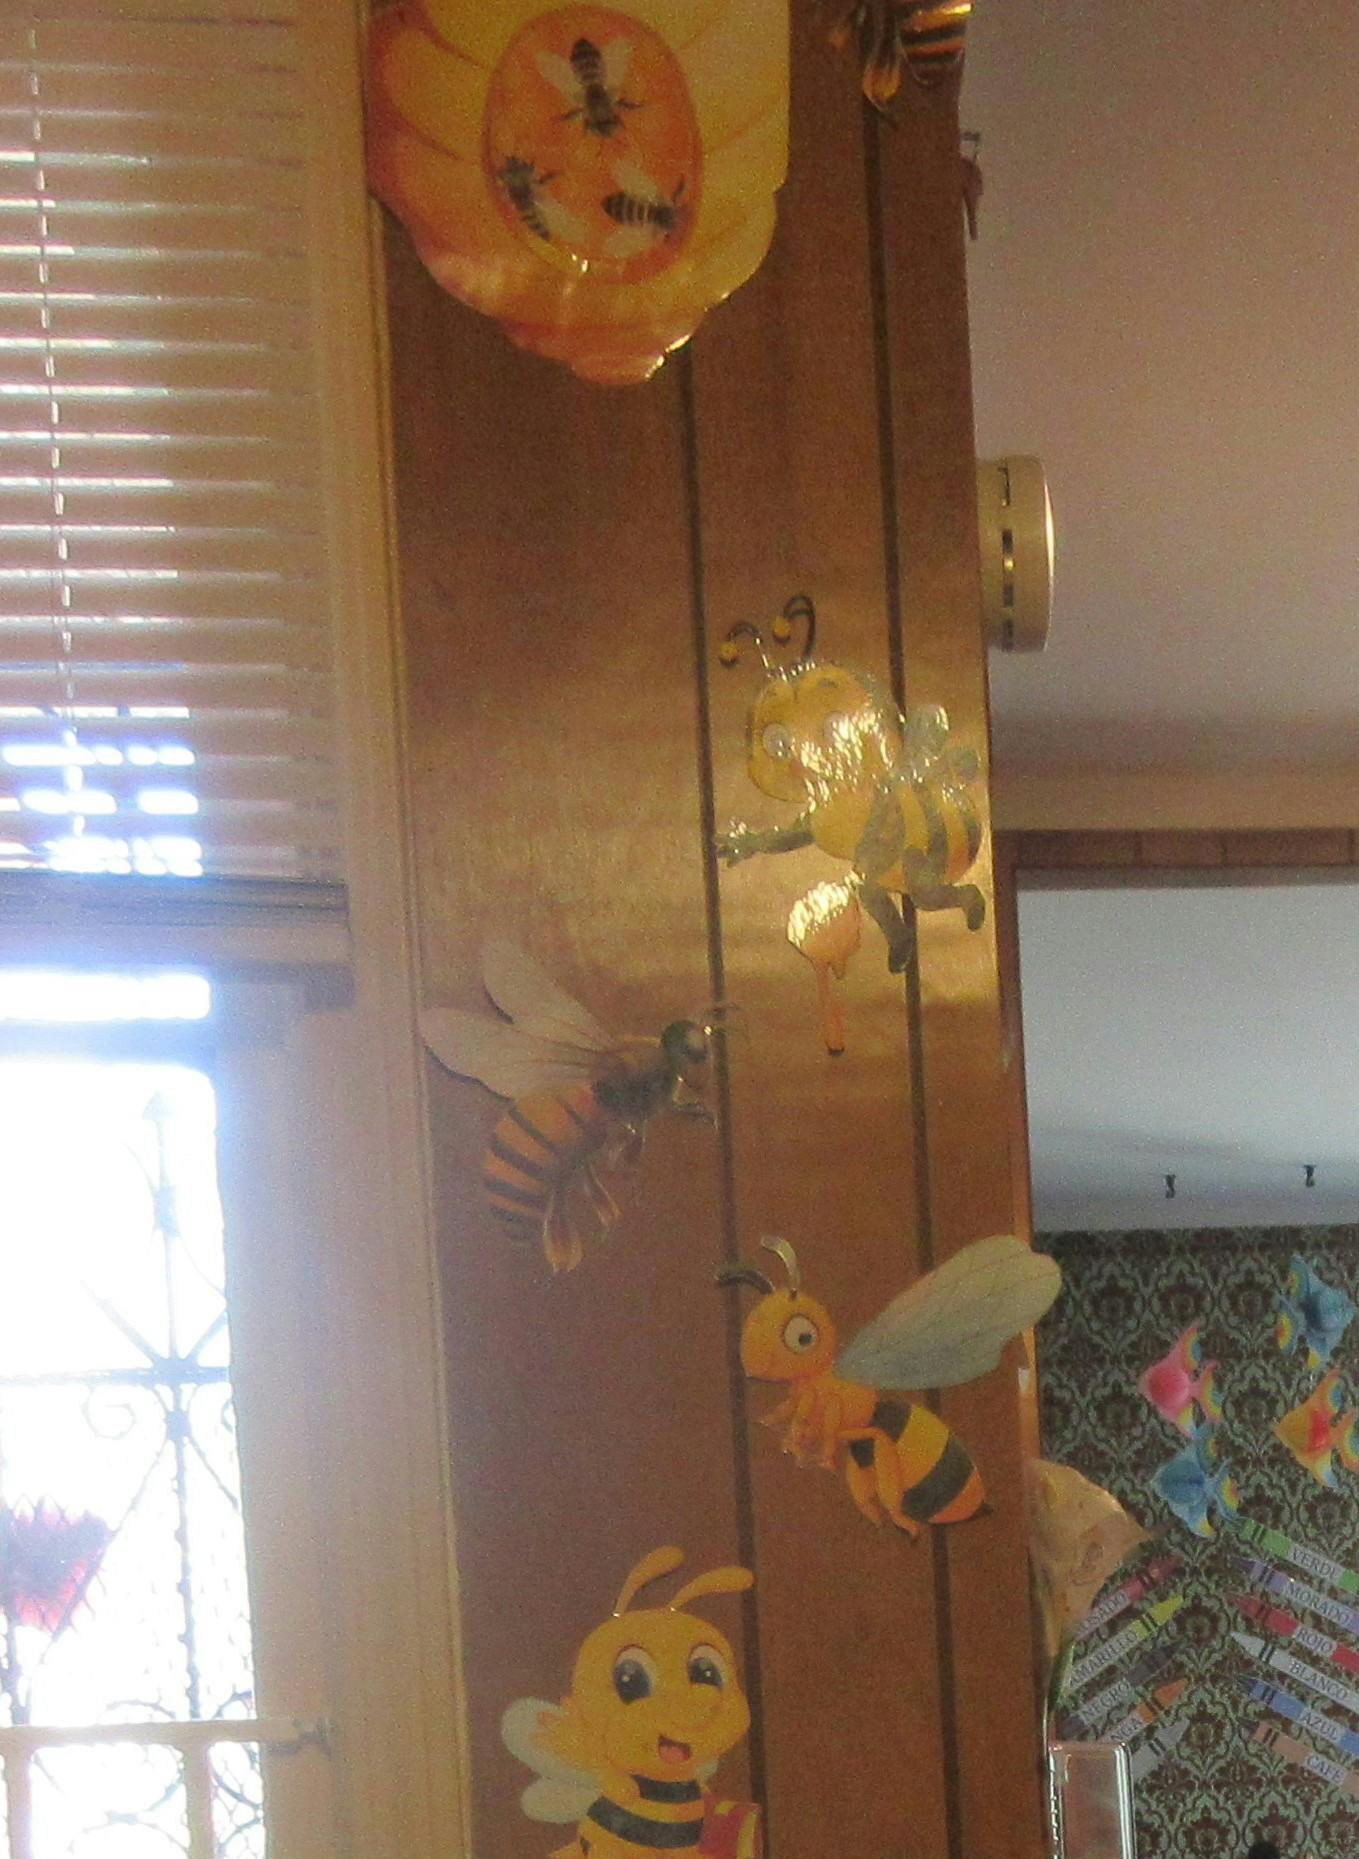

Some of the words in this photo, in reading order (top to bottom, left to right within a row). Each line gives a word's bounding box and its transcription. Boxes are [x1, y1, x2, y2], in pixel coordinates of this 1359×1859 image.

[1283, 1583, 1351, 1623] MORADO
[1069, 1629, 1138, 1687] AMARILLO
[1296, 1628, 1333, 1652] ROJO
[1082, 1680, 1132, 1721] NEGRO
[1289, 1662, 1348, 1700] BLANCO
[1301, 1712, 1338, 1741] AZUL
